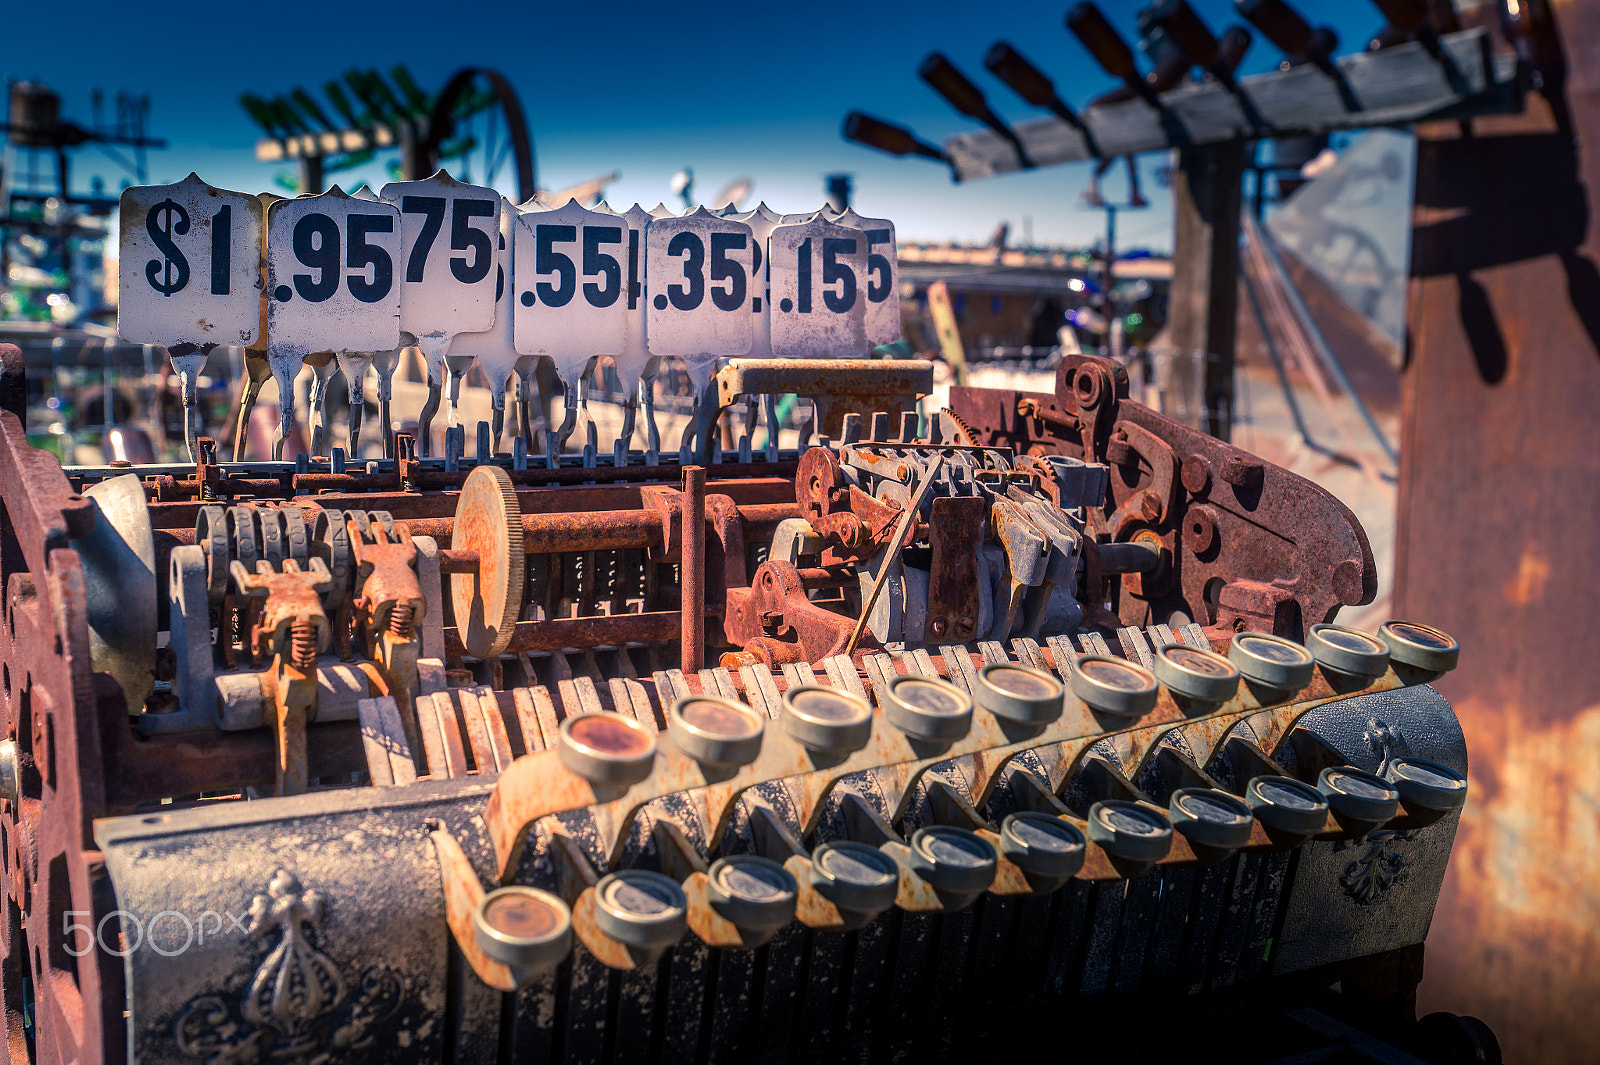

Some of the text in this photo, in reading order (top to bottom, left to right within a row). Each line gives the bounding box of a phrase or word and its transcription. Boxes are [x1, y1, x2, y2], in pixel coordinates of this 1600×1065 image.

[145, 198, 232, 297] $1
[274, 213, 393, 303] .95
[520, 224, 622, 308] .55
[653, 231, 747, 312] .35
[780, 237, 857, 314] .15
